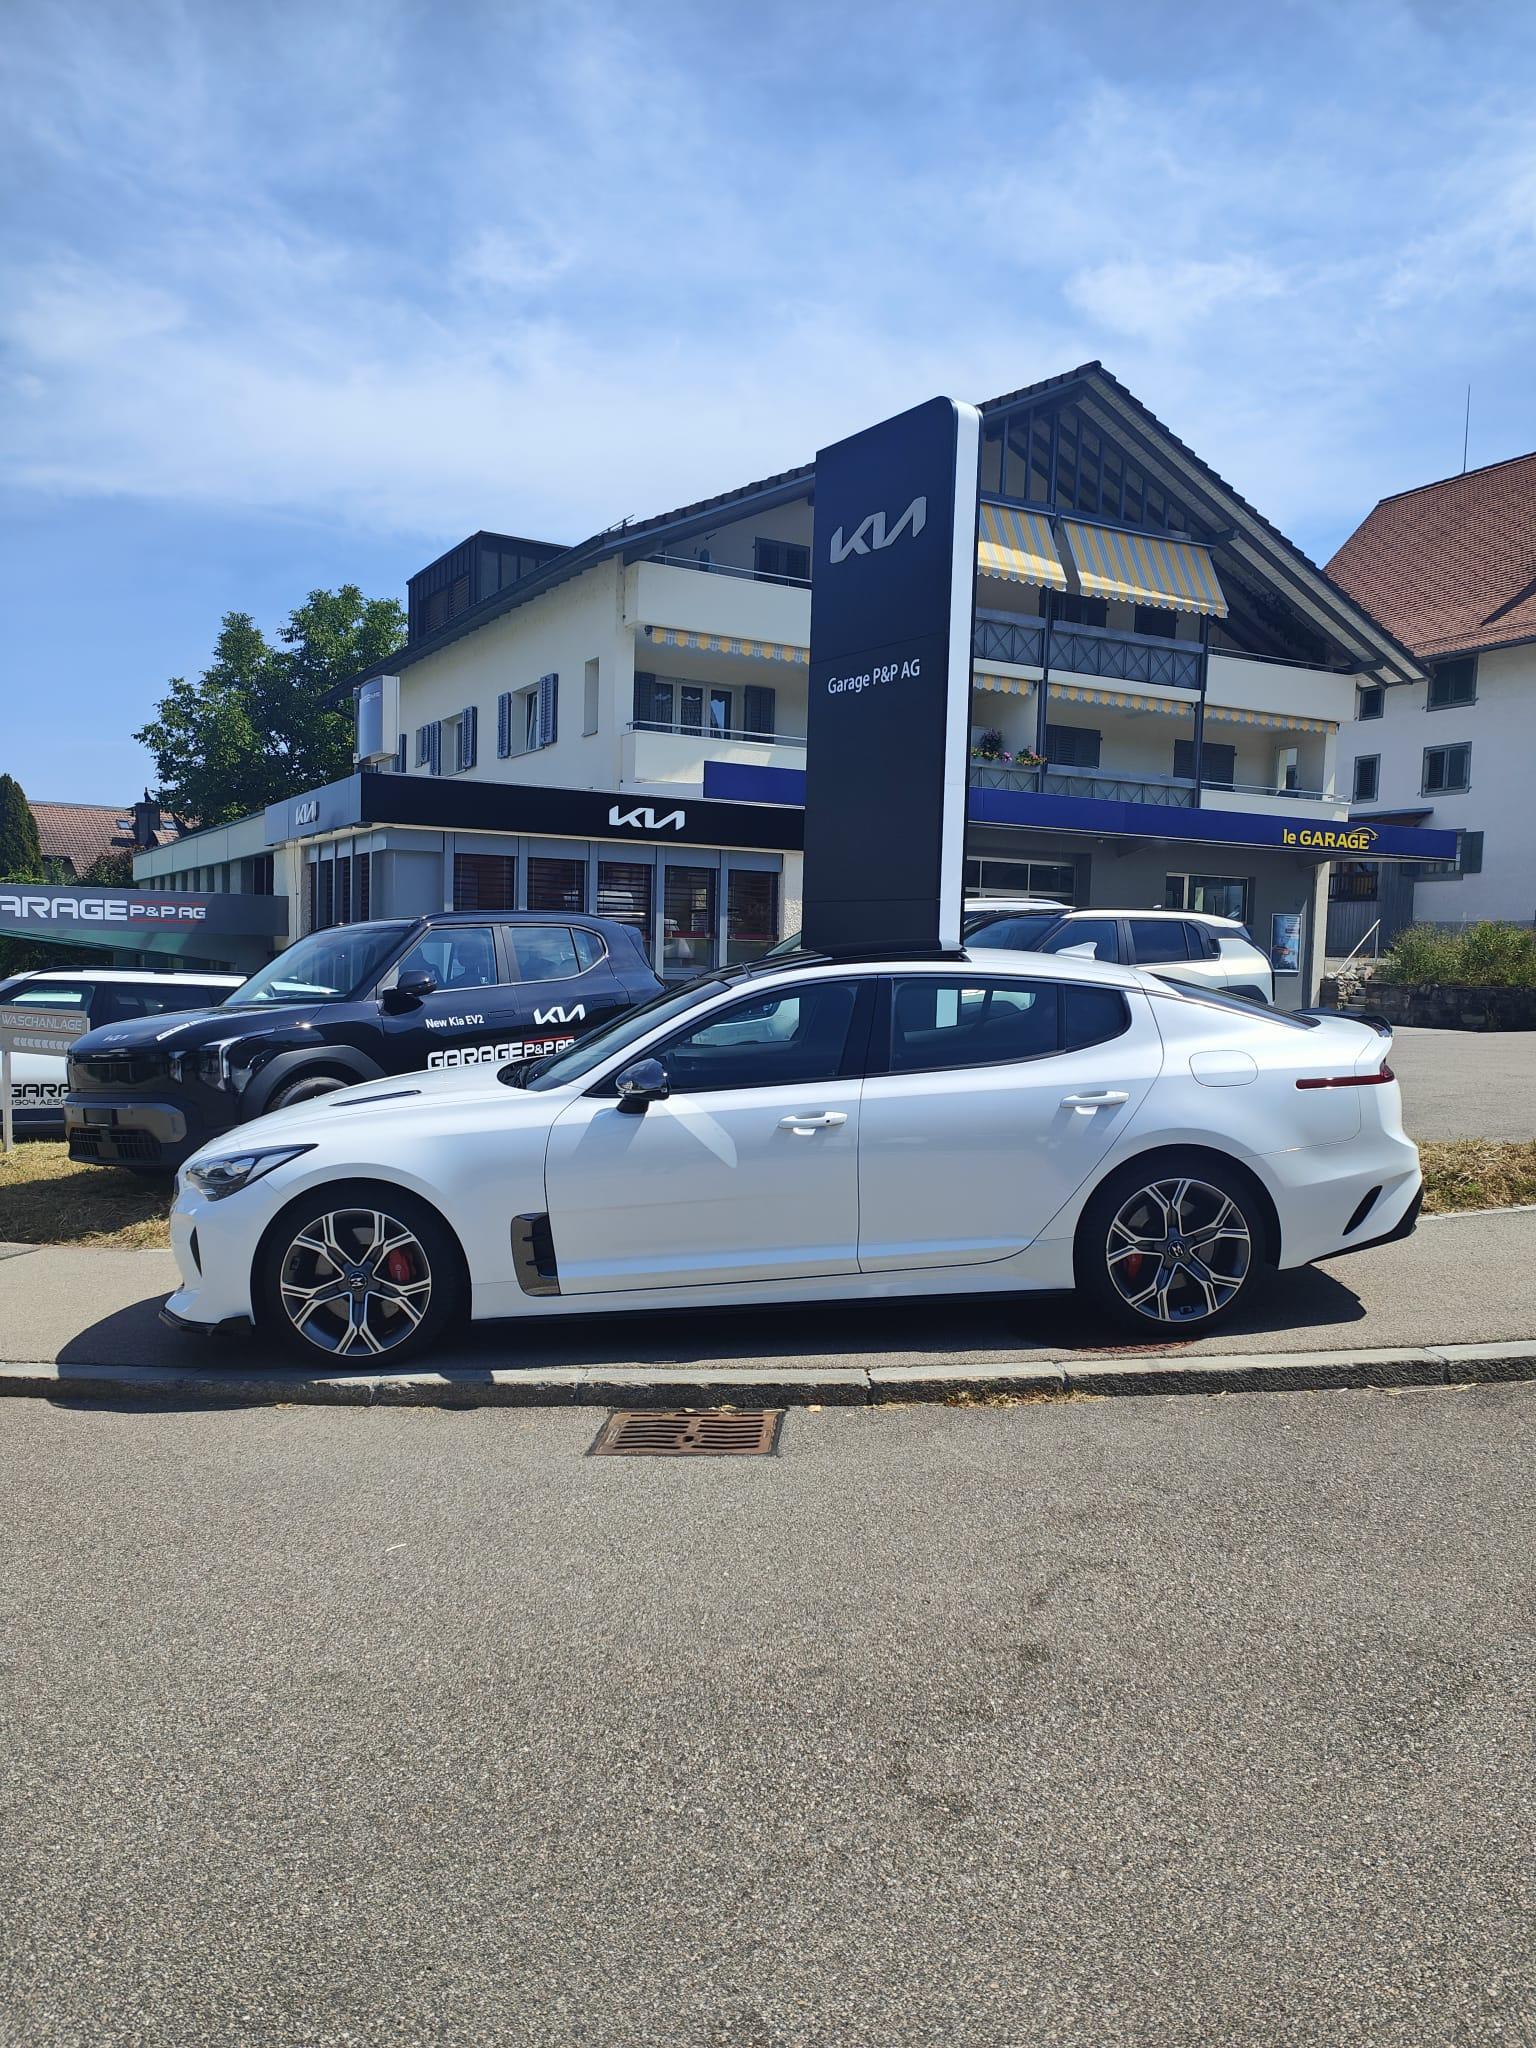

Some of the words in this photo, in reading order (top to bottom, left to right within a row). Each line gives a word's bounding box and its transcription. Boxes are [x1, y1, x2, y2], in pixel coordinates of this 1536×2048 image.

[828, 675, 870, 694] Garage
[873, 663, 899, 685] P&P
[901, 658, 921, 679] AG
[1283, 828, 1297, 845] le
[1300, 830, 1370, 850] GARAGE
[129, 904, 177, 918] P&P
[178, 906, 207, 919] AG
[1, 1013, 83, 1031] WASCHANLAGE
[425, 1018, 448, 1029] New
[448, 1016, 465, 1027] Kia
[465, 1014, 485, 1025] EV2
[427, 1042, 524, 1069] GARAGE
[524, 1041, 555, 1058] P&P
